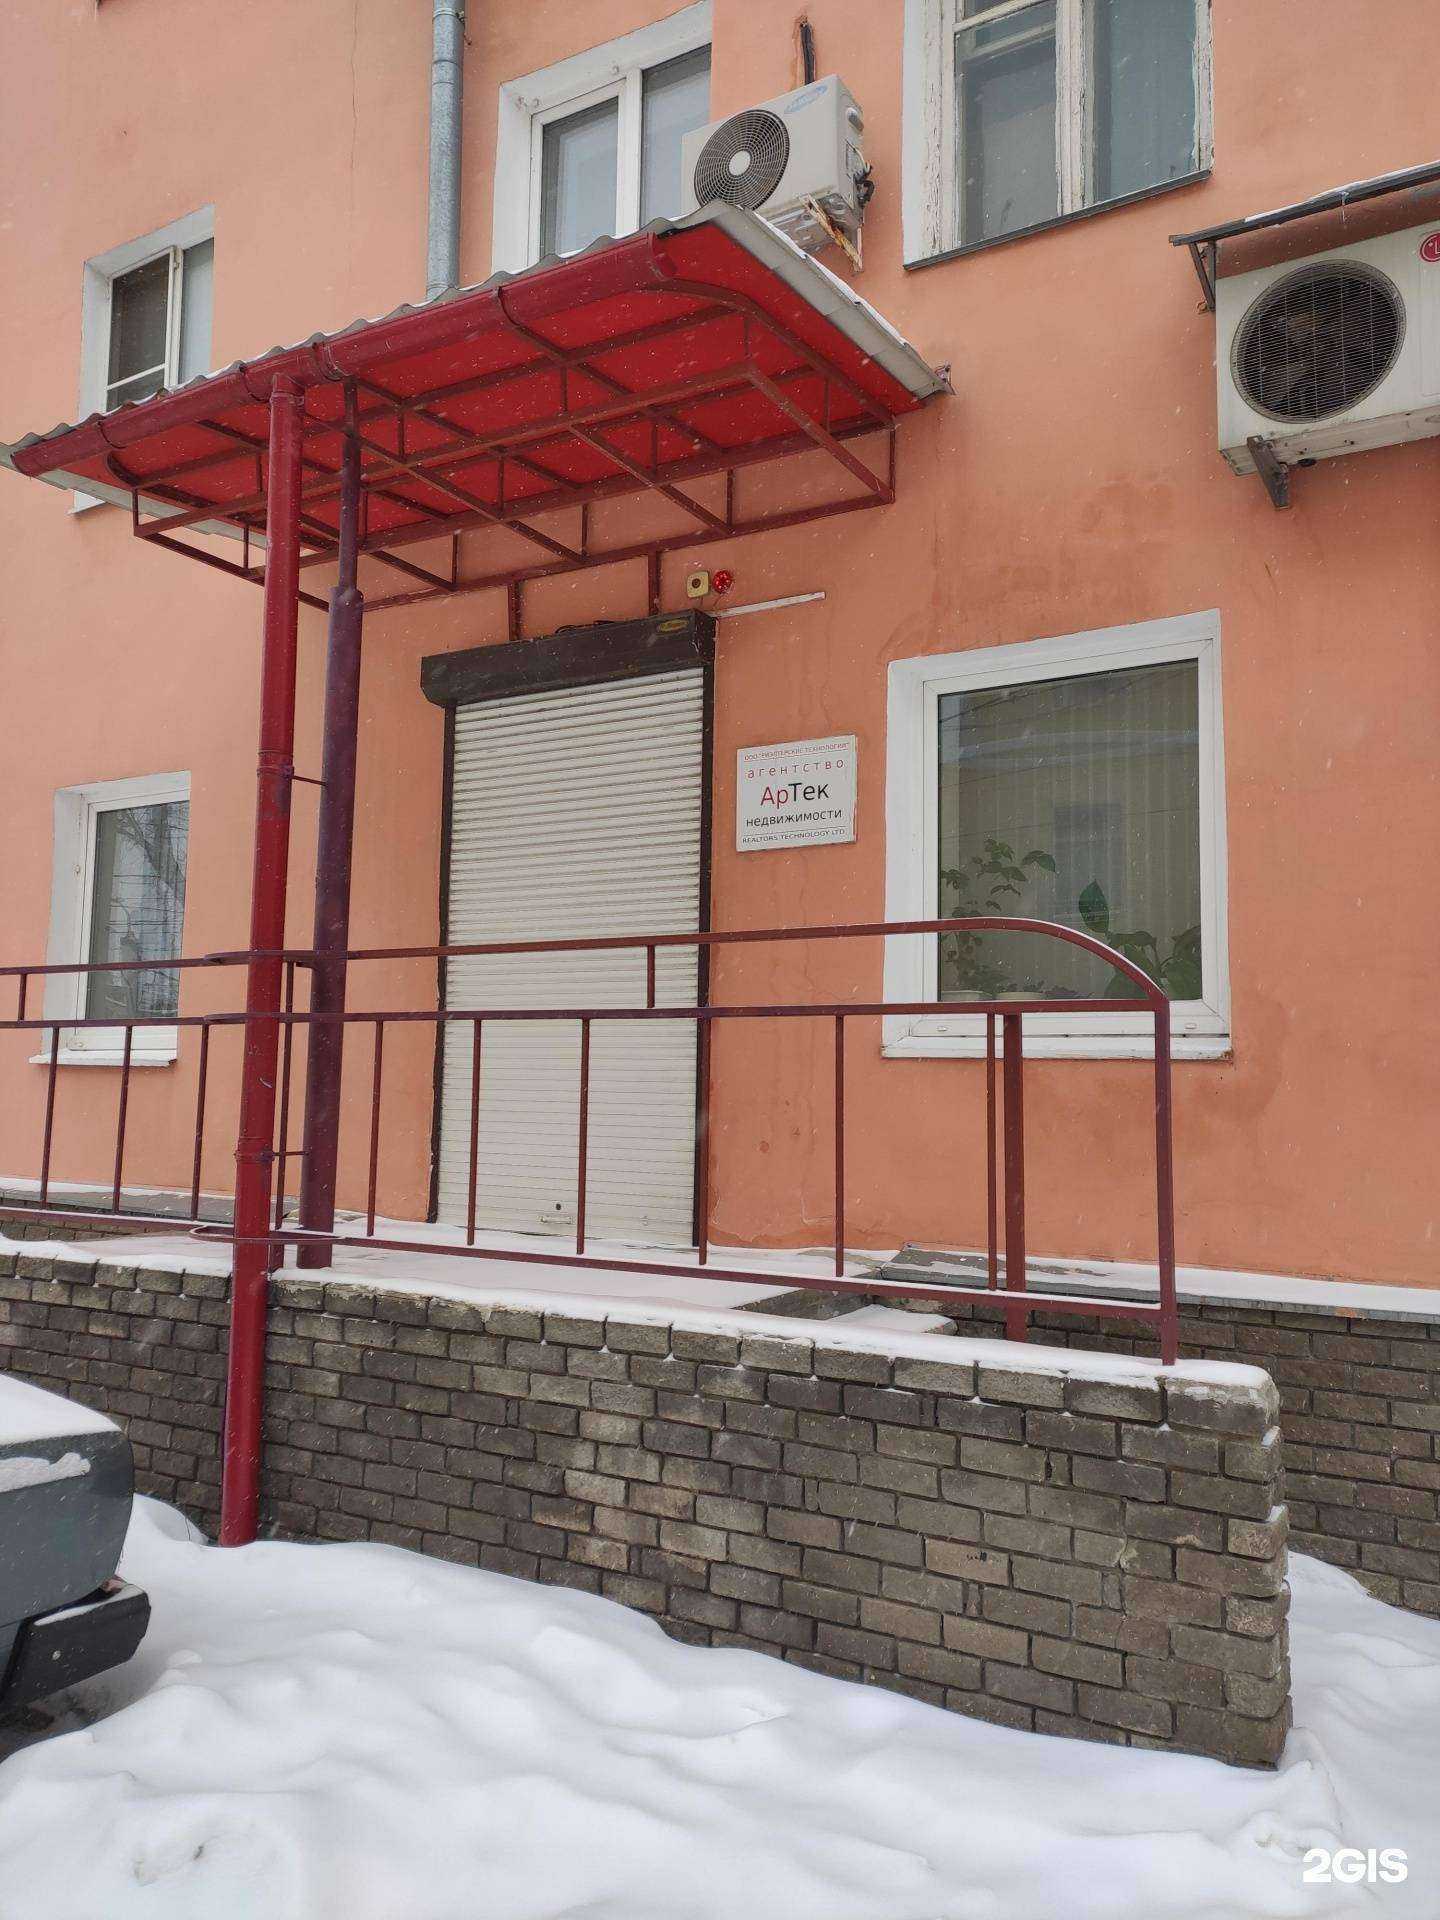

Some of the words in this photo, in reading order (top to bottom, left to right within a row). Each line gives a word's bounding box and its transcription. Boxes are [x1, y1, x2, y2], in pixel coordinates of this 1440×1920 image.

[747, 759, 844, 779] агентство
[760, 782, 829, 809] АрТек
[746, 809, 842, 828] недвижимости
[742, 835, 778, 844] REALTORS
[780, 829, 830, 841] TECHNOLOGY
